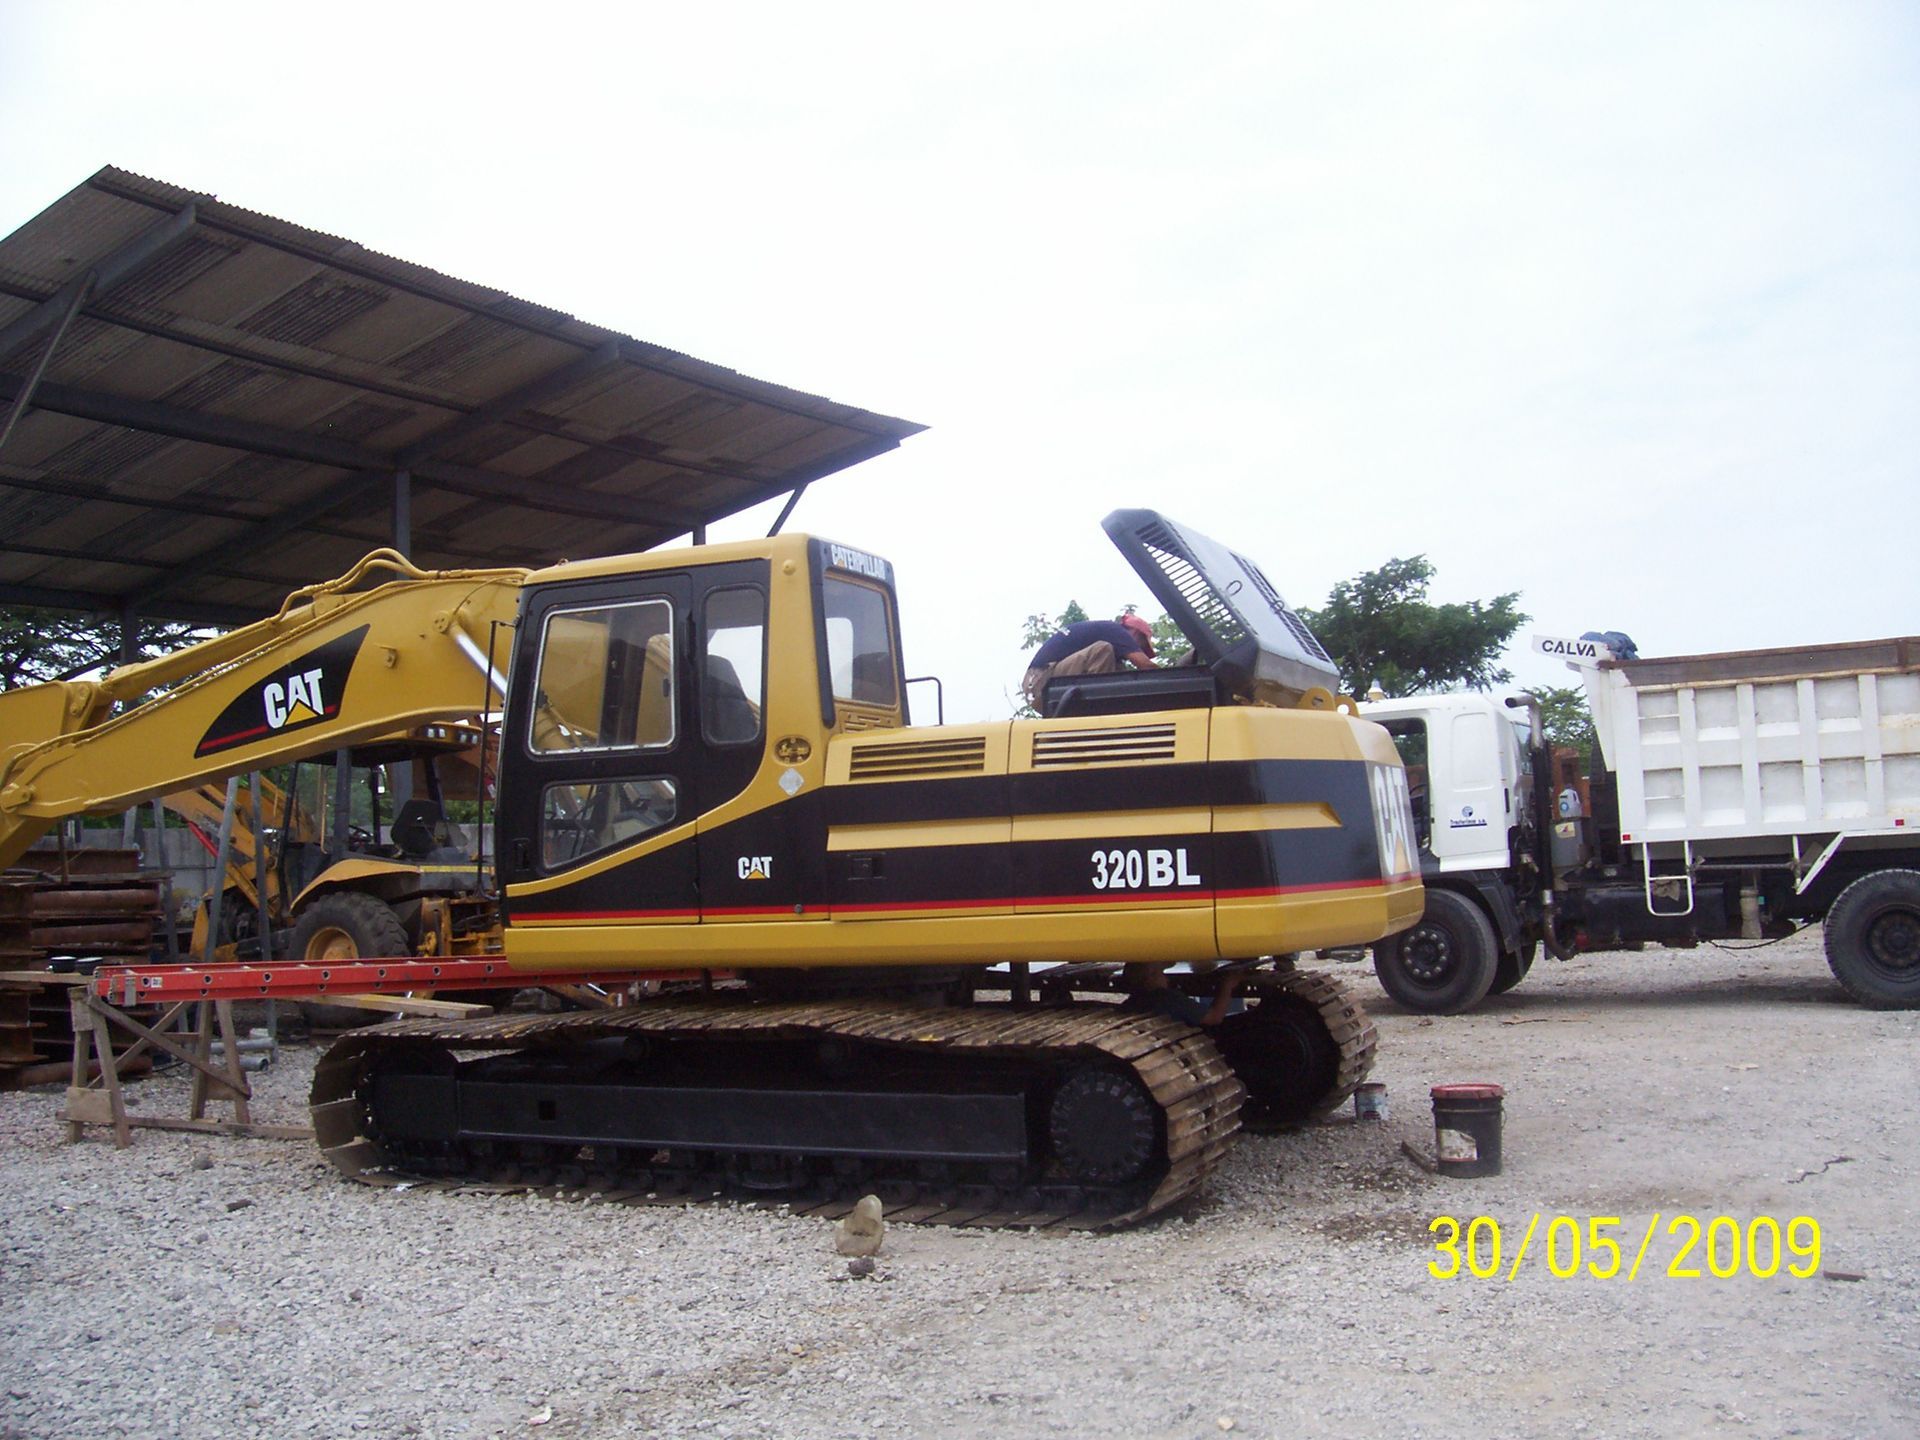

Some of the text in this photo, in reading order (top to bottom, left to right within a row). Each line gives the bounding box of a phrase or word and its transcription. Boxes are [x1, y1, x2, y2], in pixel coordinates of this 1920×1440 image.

[830, 543, 886, 580] CATERPILLAR
[1541, 639, 1597, 657] CALVA
[263, 667, 324, 729] CAT
[1373, 765, 1413, 875] CAT
[737, 855, 773, 880] CAT
